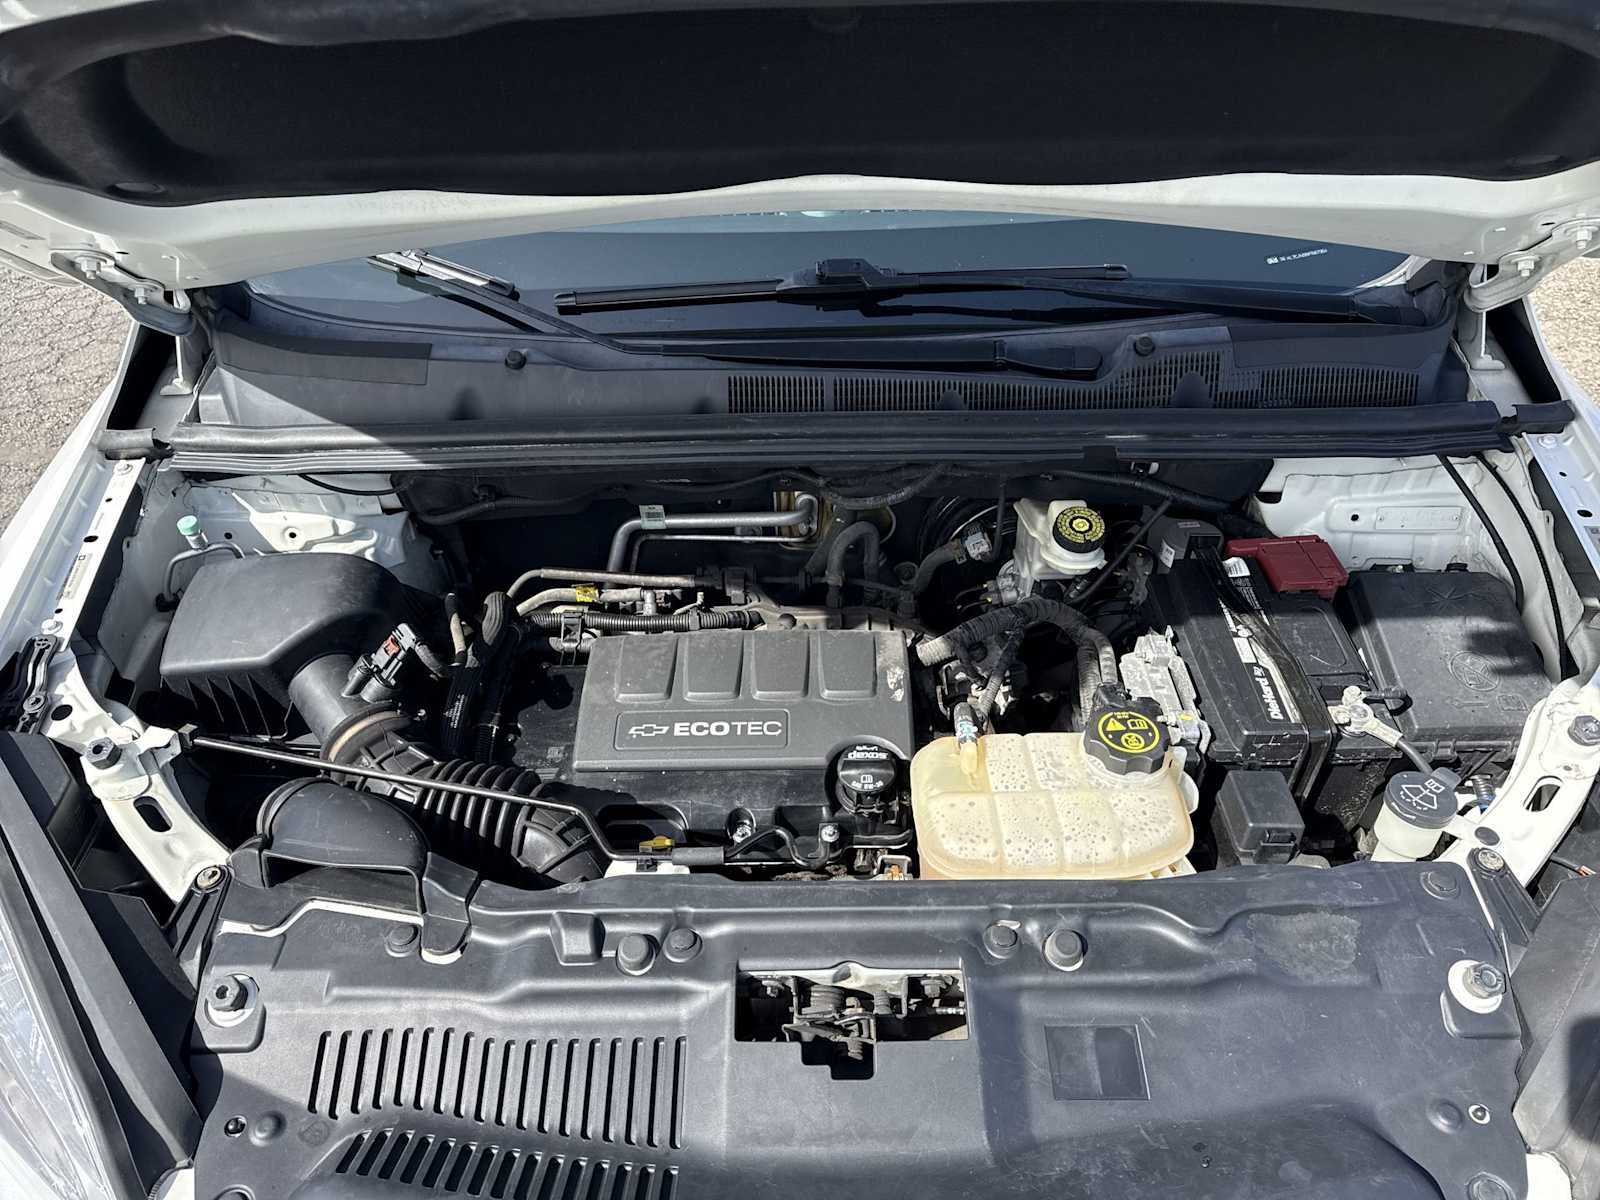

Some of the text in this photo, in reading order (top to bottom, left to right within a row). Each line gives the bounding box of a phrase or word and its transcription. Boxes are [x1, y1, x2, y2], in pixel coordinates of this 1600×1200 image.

[1254, 677, 1285, 720] DieHard
[673, 720, 783, 737] ECOTEC
[847, 750, 889, 759] dexos
